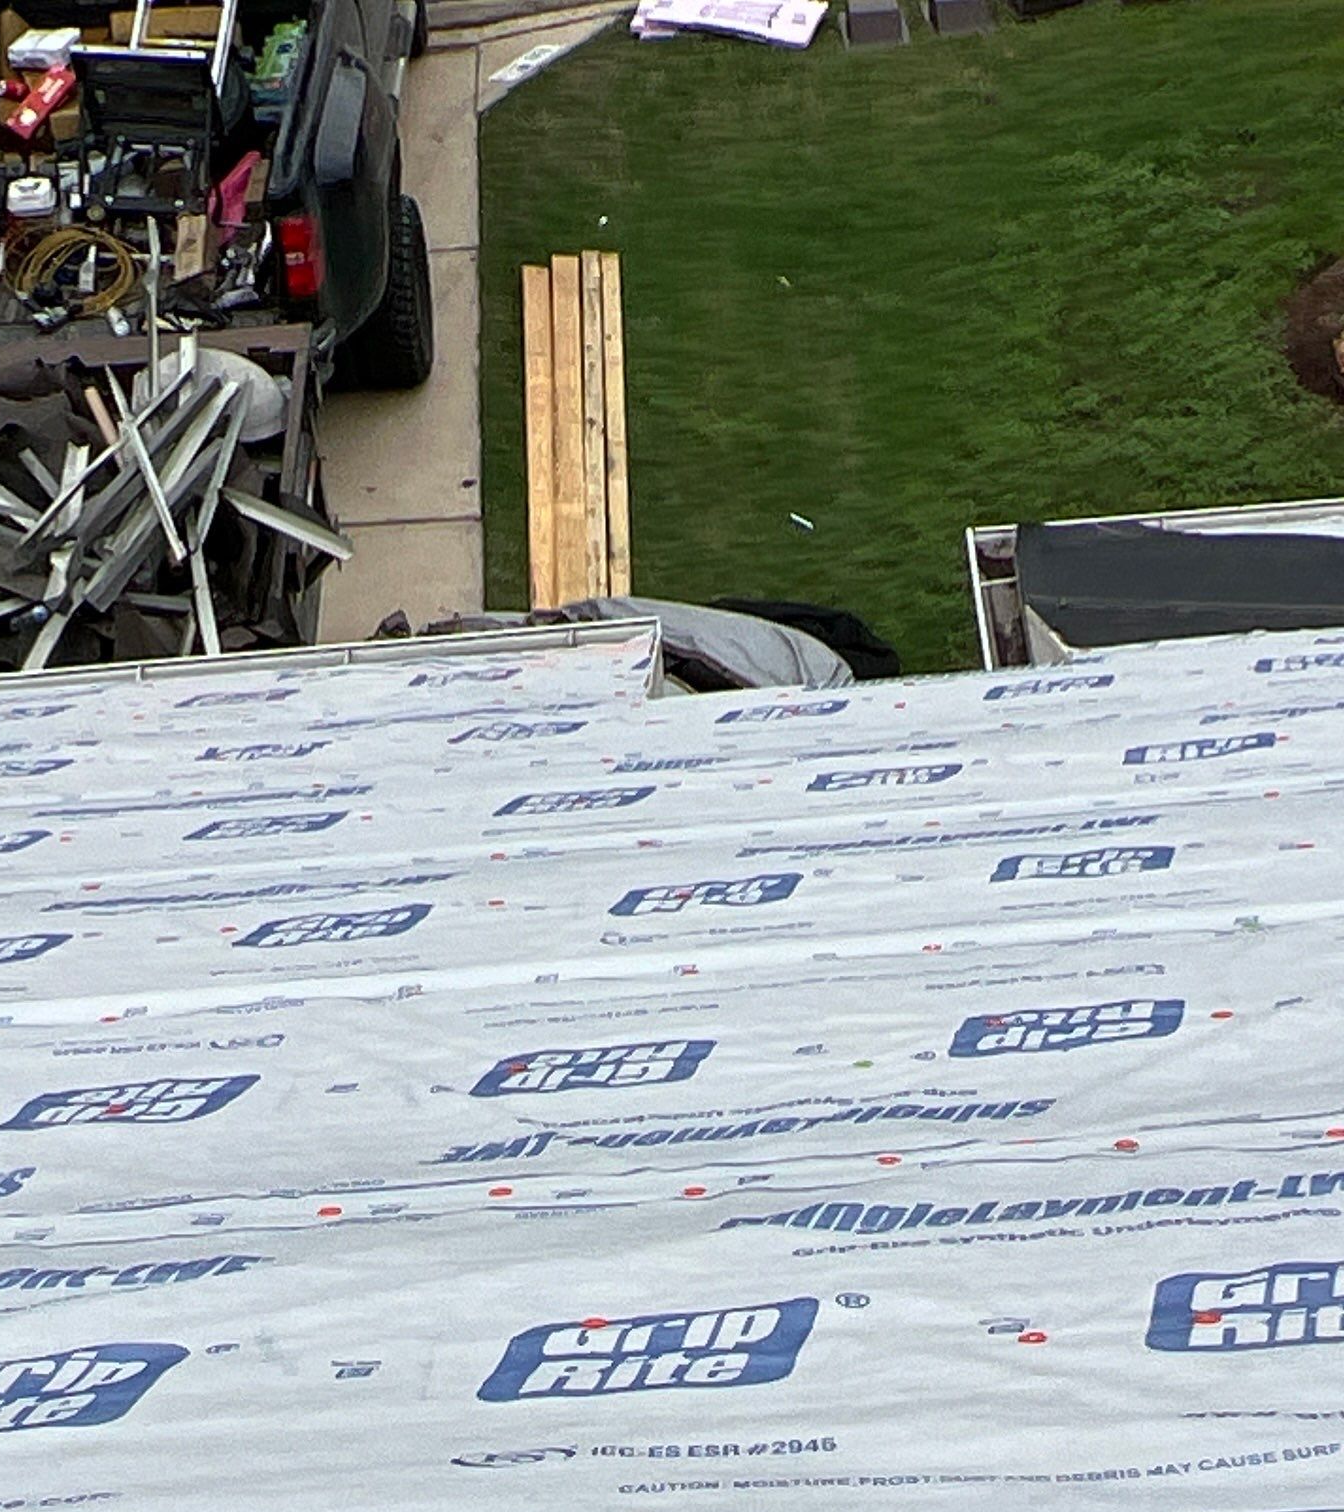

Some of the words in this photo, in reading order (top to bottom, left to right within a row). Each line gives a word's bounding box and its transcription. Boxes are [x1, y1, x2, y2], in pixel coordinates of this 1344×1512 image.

[543, 1304, 782, 1356] Grip
[519, 1351, 750, 1395] Rite
[1207, 1451, 1289, 1472] CAUSE
